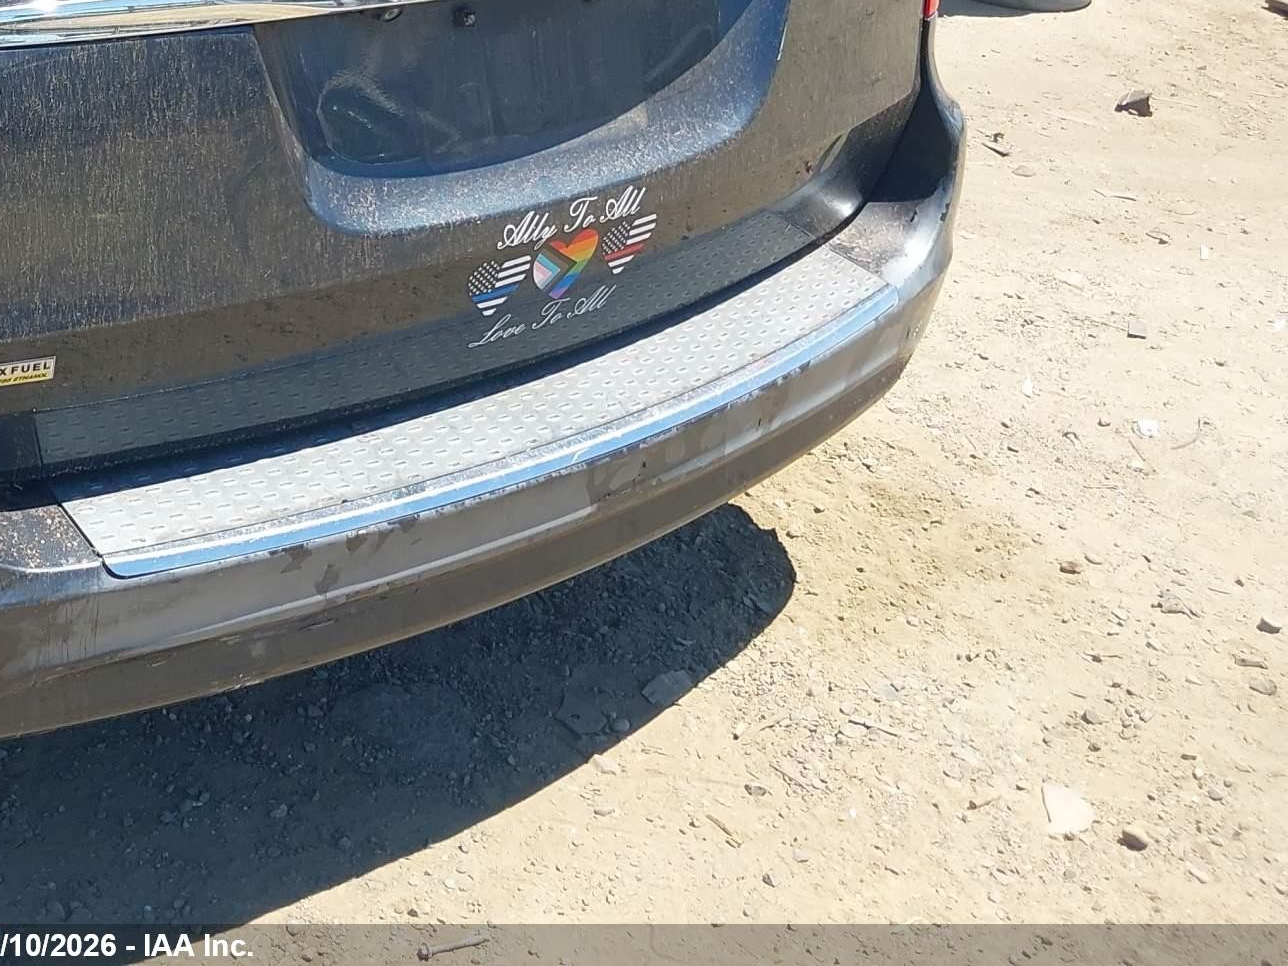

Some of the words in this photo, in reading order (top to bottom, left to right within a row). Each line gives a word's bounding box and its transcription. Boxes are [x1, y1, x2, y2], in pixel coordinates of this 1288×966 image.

[497, 211, 557, 250] Ally
[564, 196, 598, 233] To
[600, 186, 646, 223] All
[468, 314, 526, 348] Love
[532, 298, 570, 330] To
[567, 285, 617, 319] All
